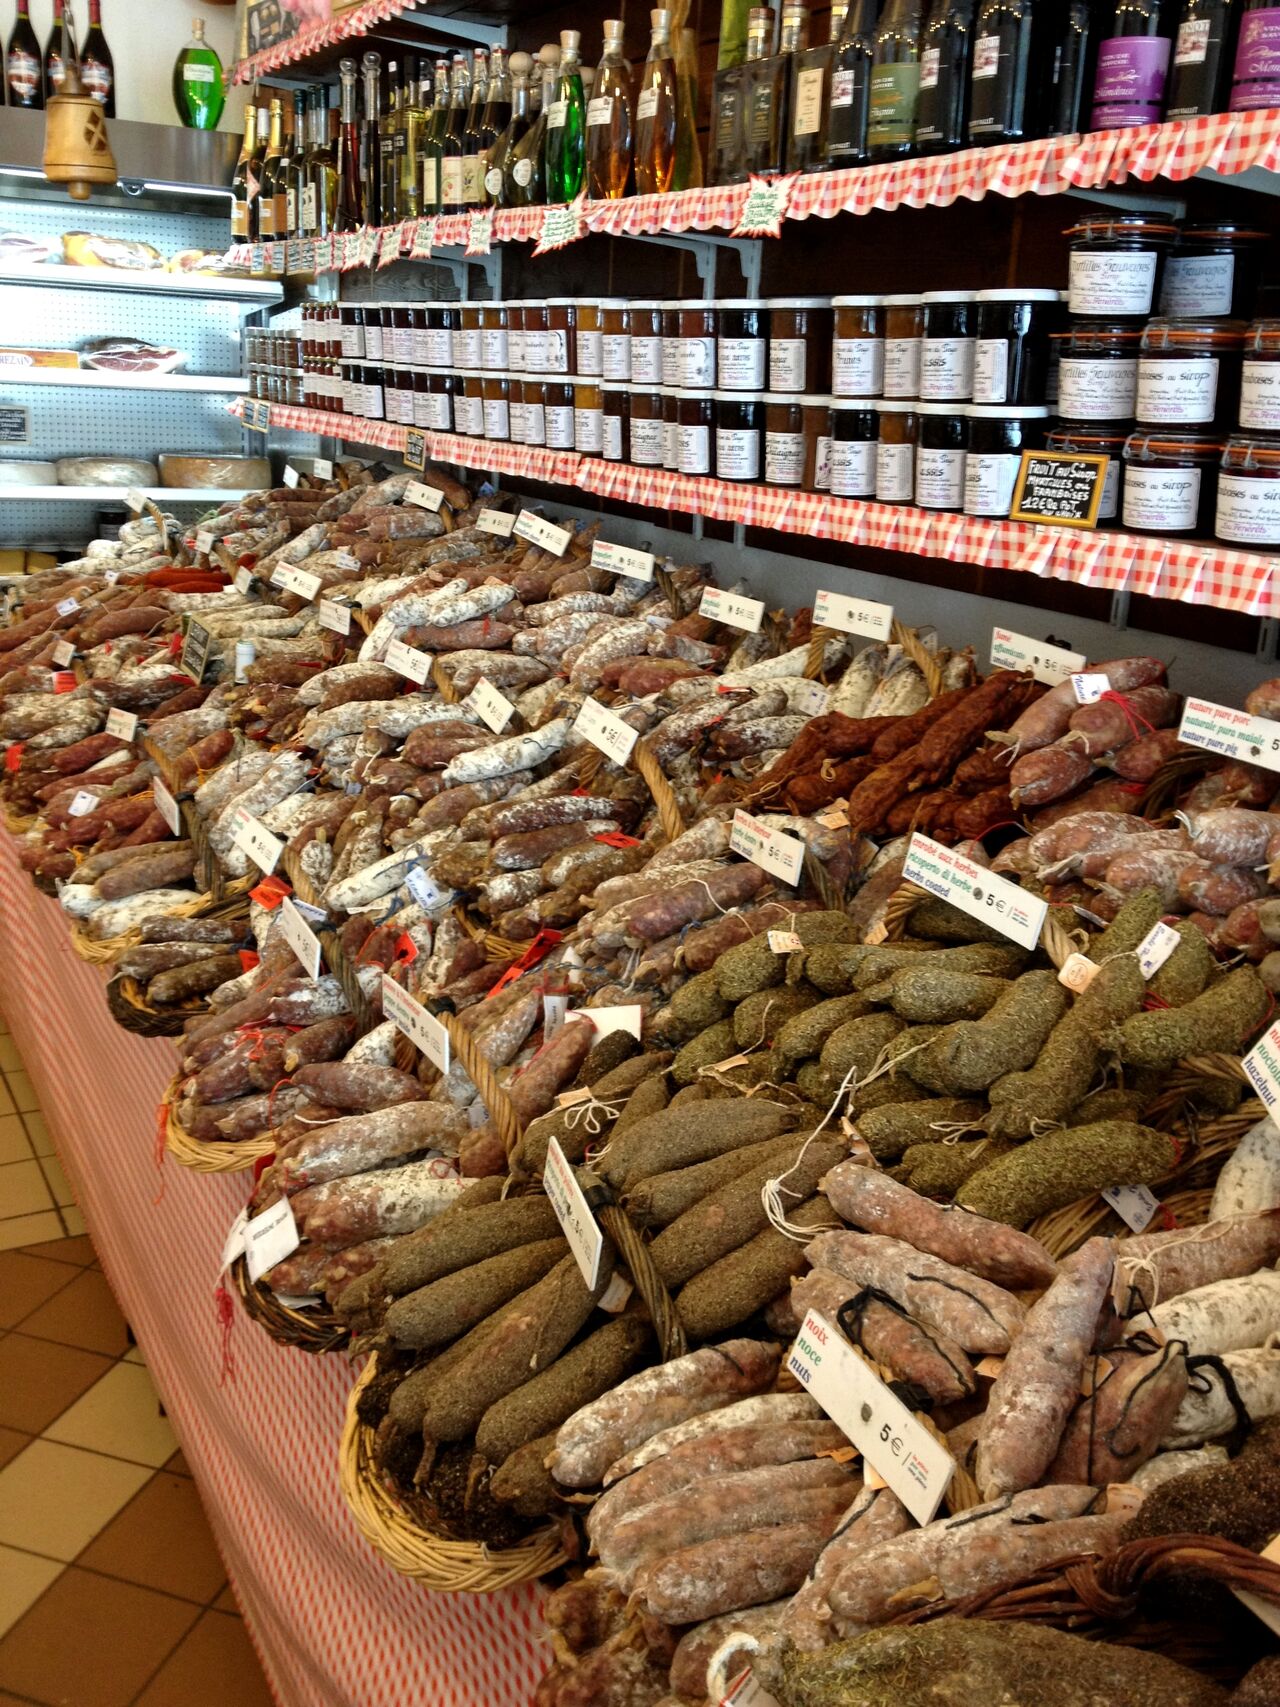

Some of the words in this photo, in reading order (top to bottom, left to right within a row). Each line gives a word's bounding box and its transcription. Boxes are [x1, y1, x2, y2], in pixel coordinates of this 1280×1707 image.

[1244, 1056, 1278, 1106] hazelnut
[805, 1317, 829, 1346] noix
[796, 1337, 823, 1366] noce
[789, 1356, 813, 1384] nuts
